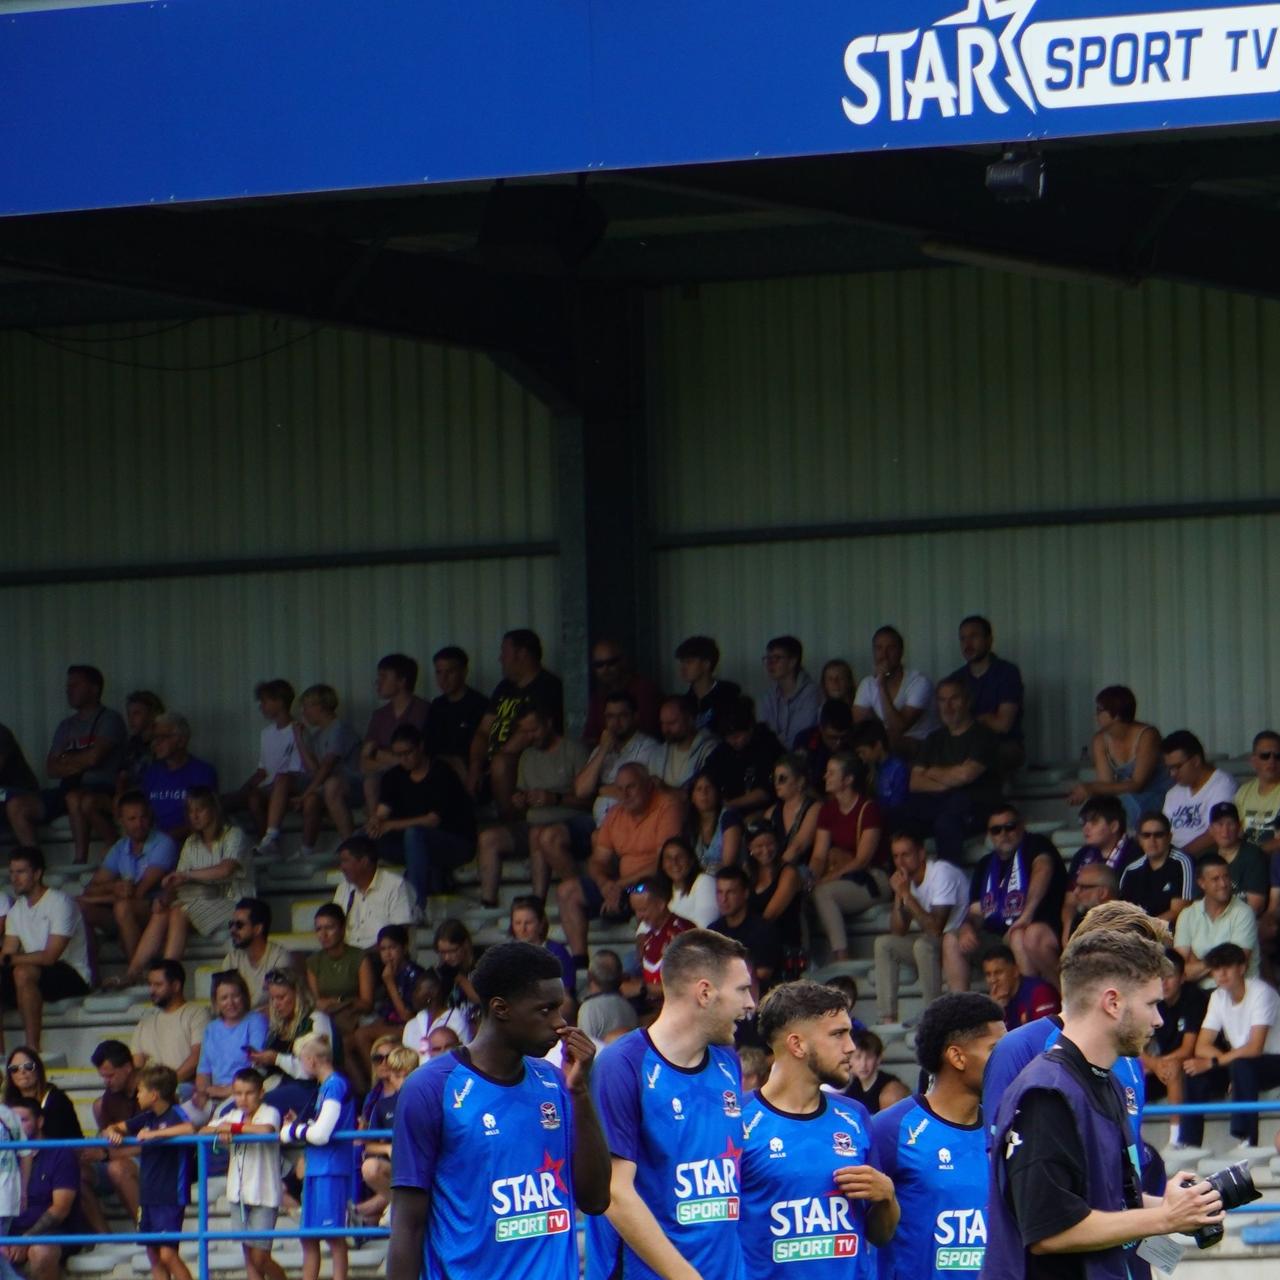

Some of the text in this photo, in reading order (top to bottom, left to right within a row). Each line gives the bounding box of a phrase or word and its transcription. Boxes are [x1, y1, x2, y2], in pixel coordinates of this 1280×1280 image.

[842, 26, 1279, 126] STAR SPORT TV
[149, 789, 187, 801] HILFIGE
[492, 1172, 562, 1215] STAR
[675, 1158, 738, 1199] STAR
[498, 1212, 566, 1239] SPORT TV
[679, 1200, 739, 1222] SPORT TV
[770, 1196, 854, 1236] STAR
[934, 1209, 987, 1244] STA
[777, 1238, 855, 1259] SPORT TV
